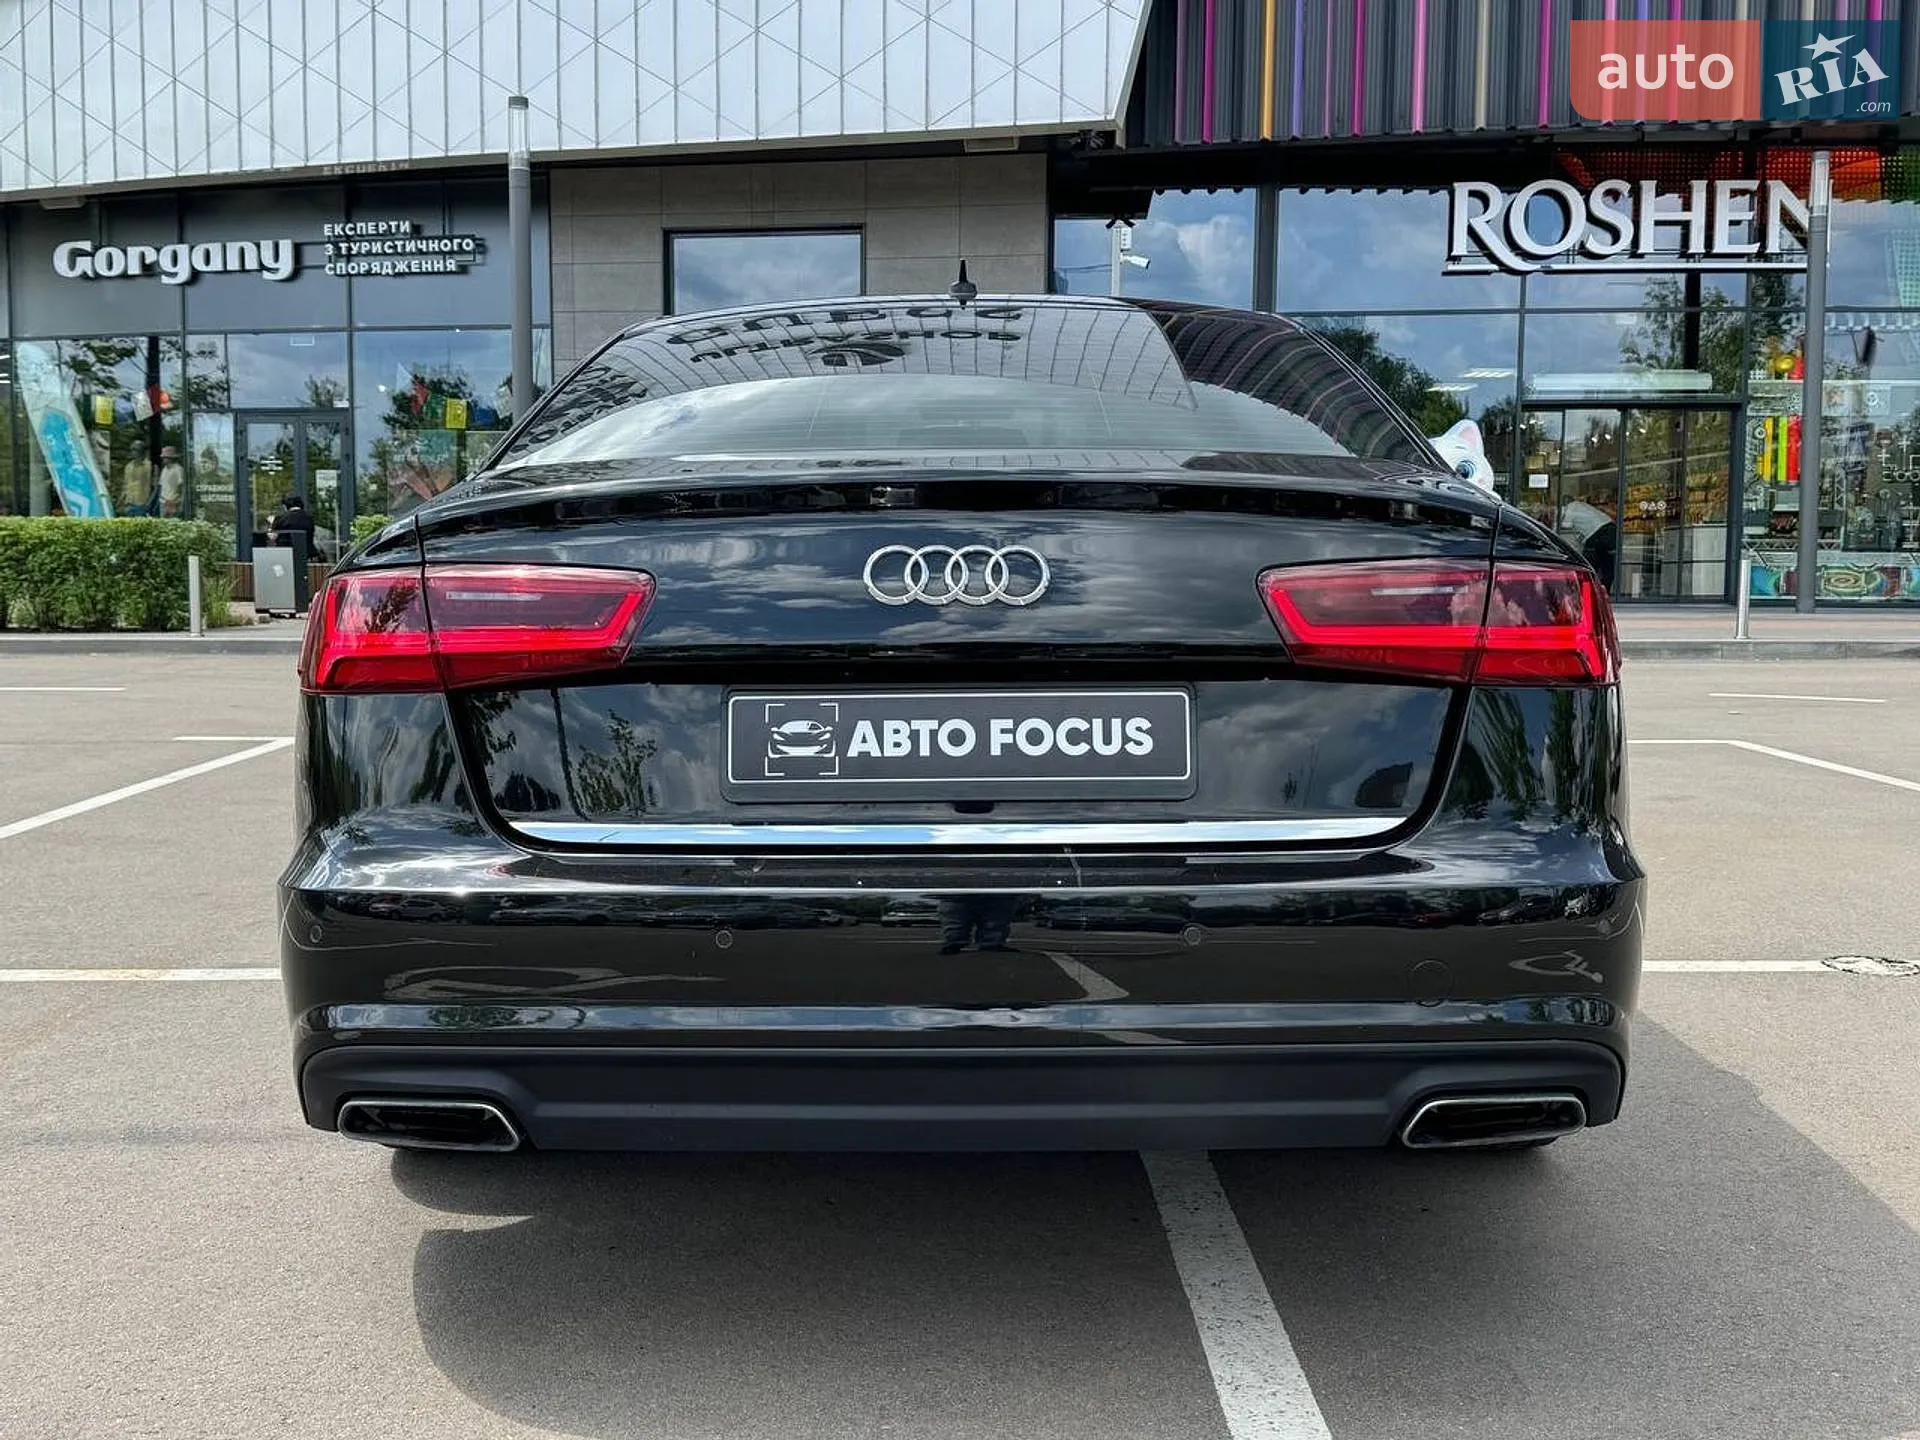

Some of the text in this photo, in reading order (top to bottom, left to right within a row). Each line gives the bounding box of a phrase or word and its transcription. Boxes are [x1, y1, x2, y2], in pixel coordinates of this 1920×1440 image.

[323, 220, 411, 236] ЕКСПЕРТИ
[1451, 179, 1833, 271] ROSHEN
[324, 238, 475, 256] З ТУРИСТИЧНОГО
[52, 239, 295, 285] Gorgany
[325, 259, 457, 276] СПОРЯДЖЕННЯ
[846, 717, 1154, 757] АВТО FOCUS
